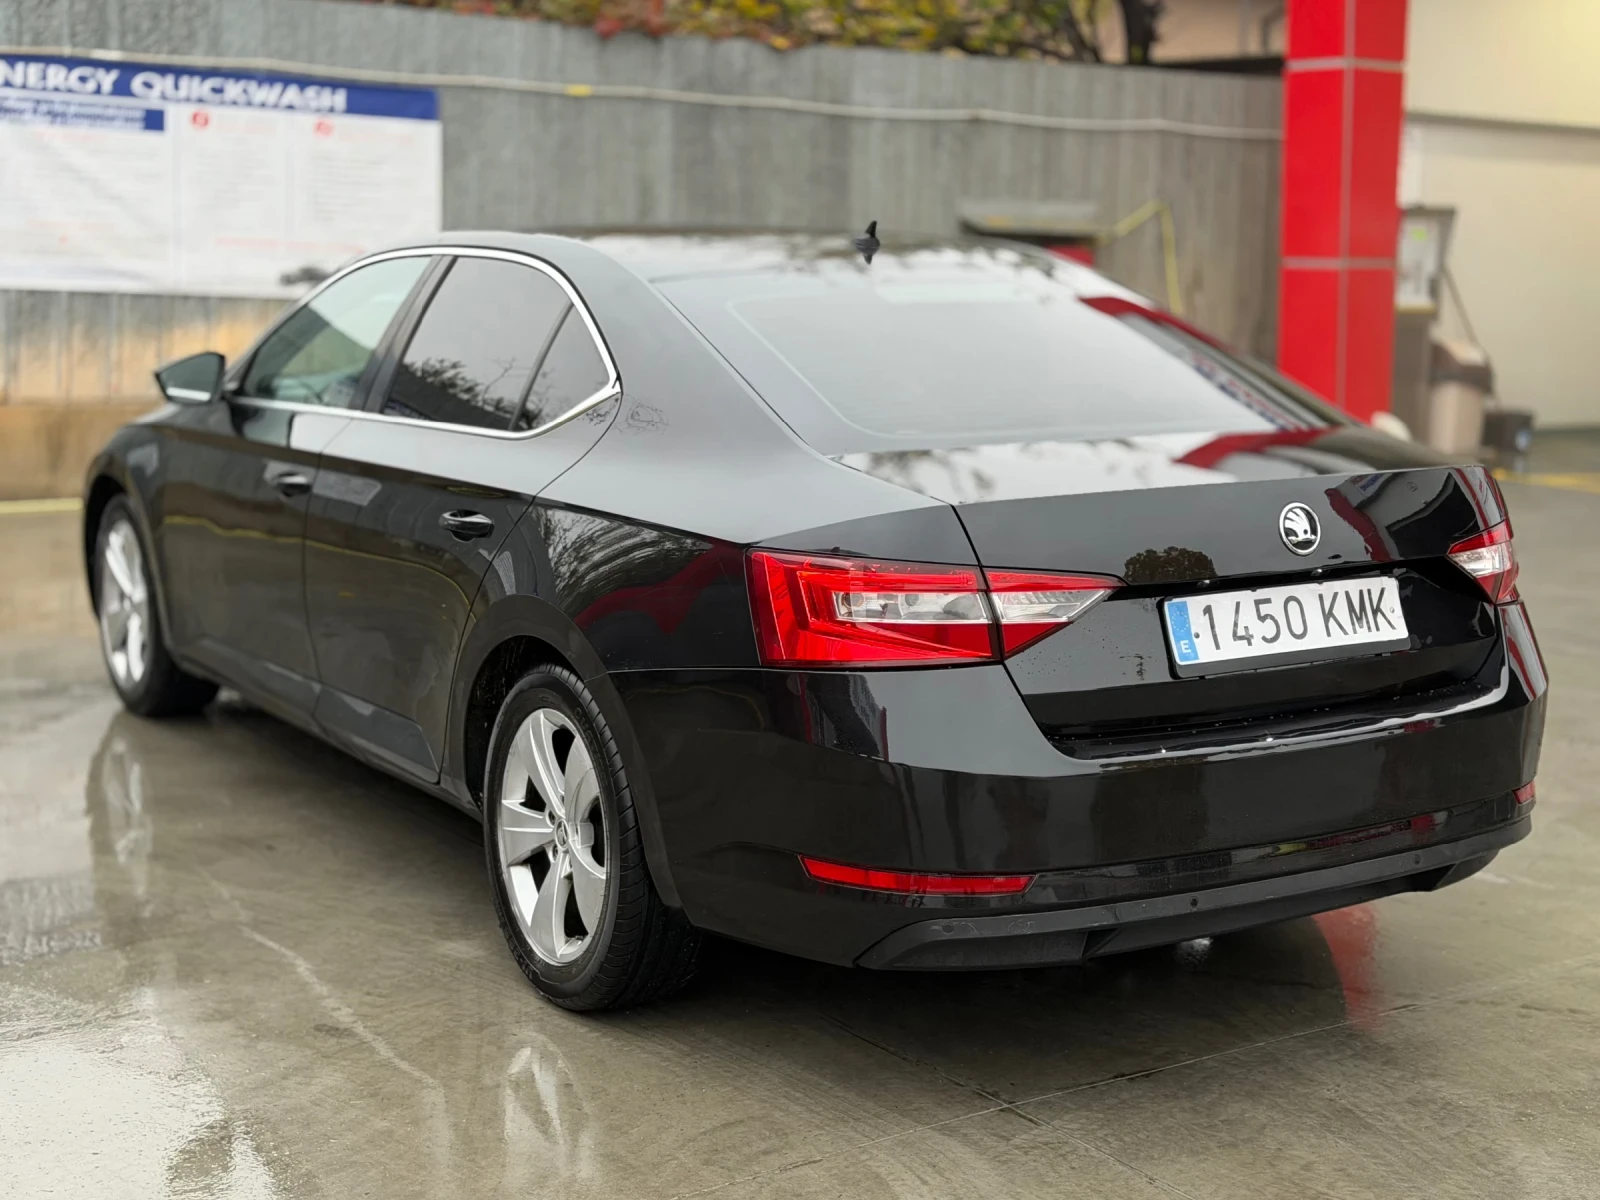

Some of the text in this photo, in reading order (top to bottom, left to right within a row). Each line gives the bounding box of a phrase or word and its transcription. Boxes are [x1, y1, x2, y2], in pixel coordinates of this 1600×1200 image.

[0, 59, 347, 113] NERGY QUICKWASH
[1202, 587, 1397, 650] 1450 KMK
[1180, 639, 1191, 653] E
